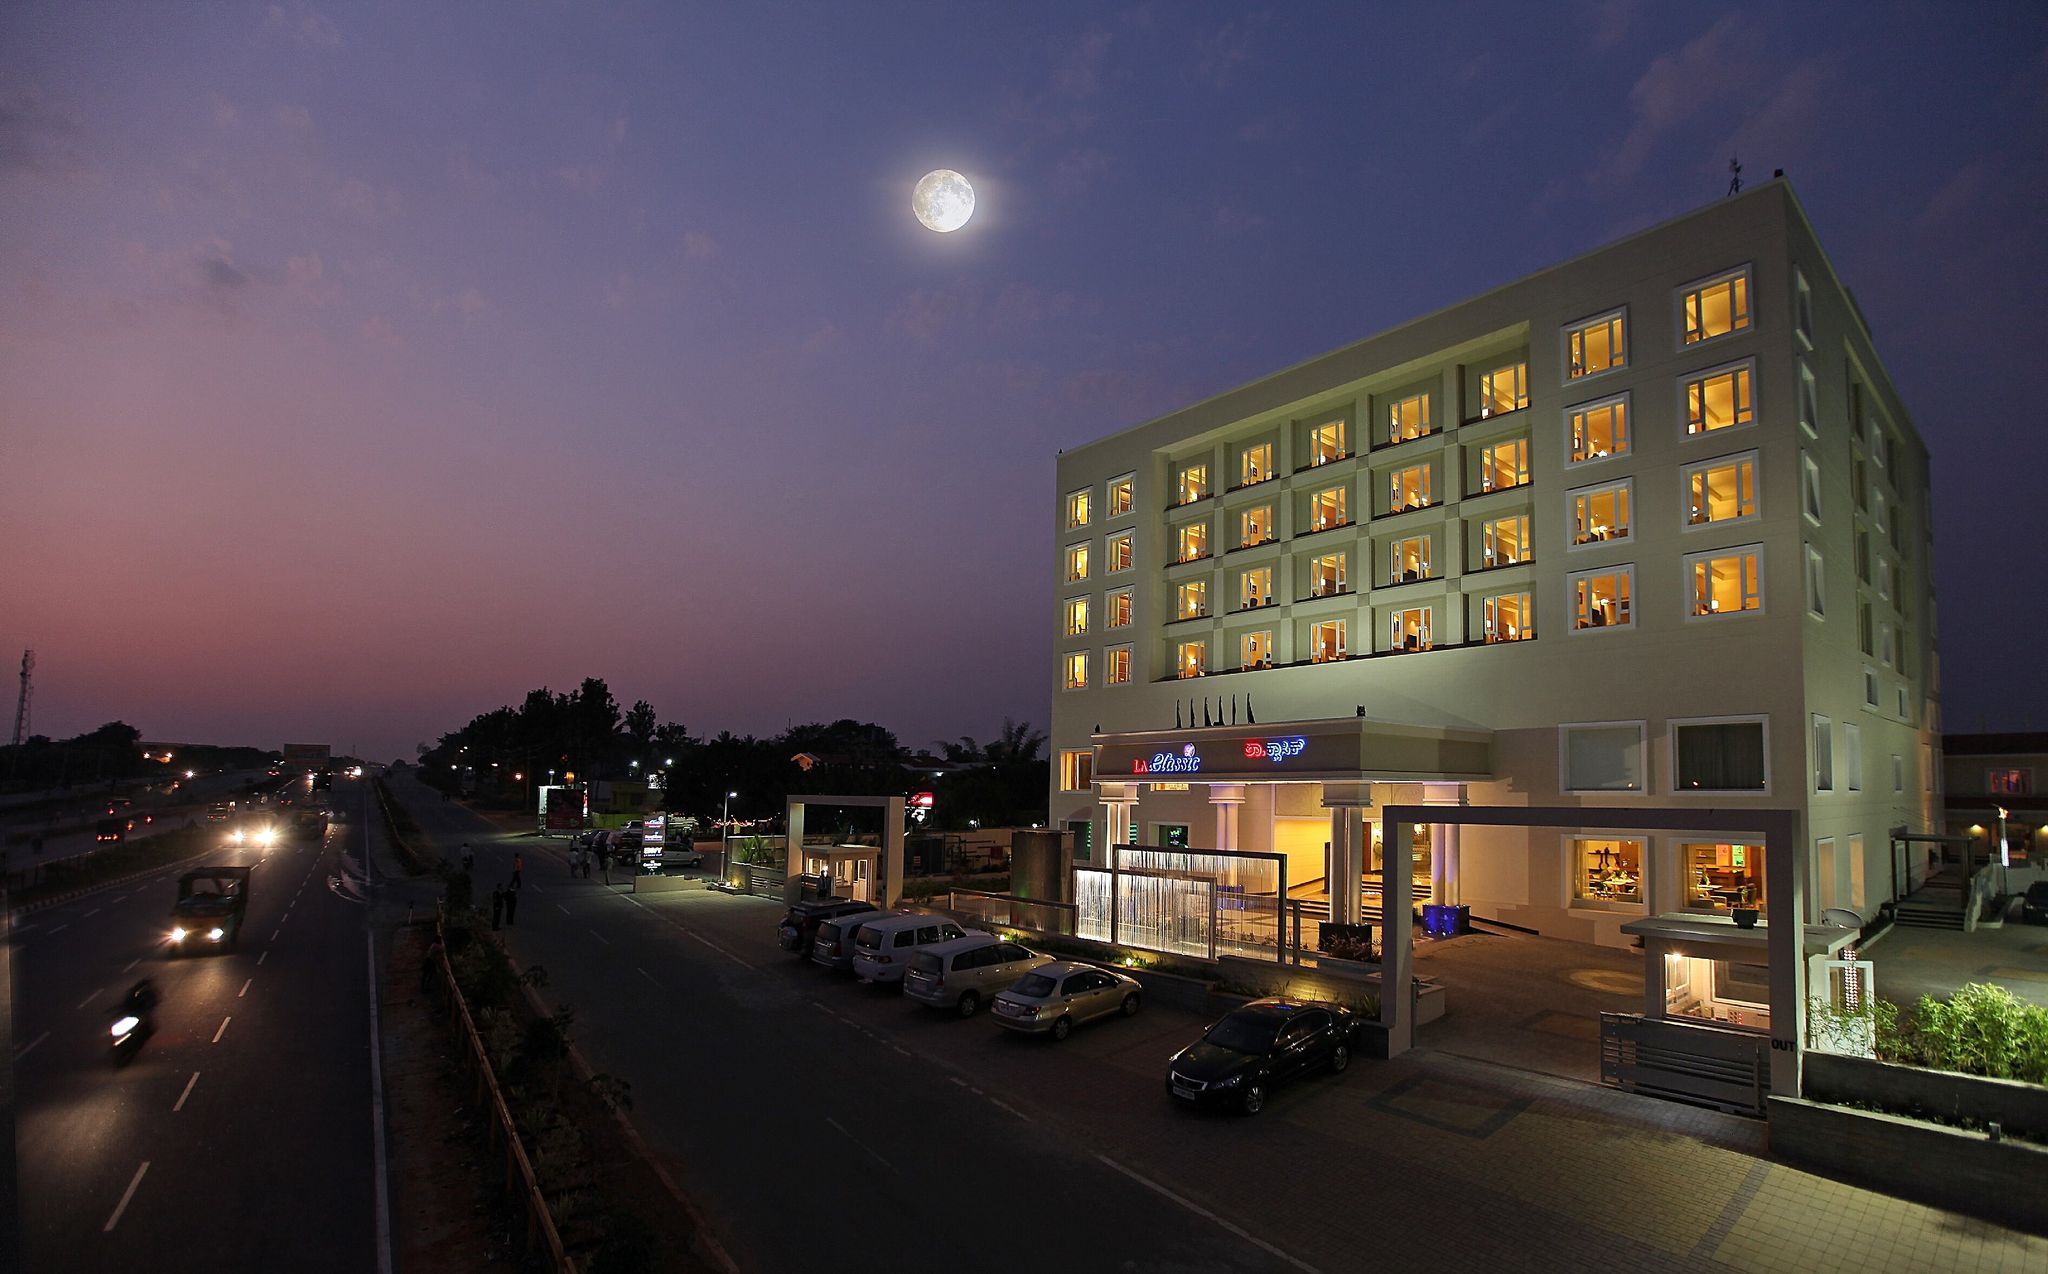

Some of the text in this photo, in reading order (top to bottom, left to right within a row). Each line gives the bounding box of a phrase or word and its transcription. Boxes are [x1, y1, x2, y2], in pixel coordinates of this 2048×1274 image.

[1133, 752, 1201, 773] LA Classic
[1771, 1039, 1796, 1052] OUT
